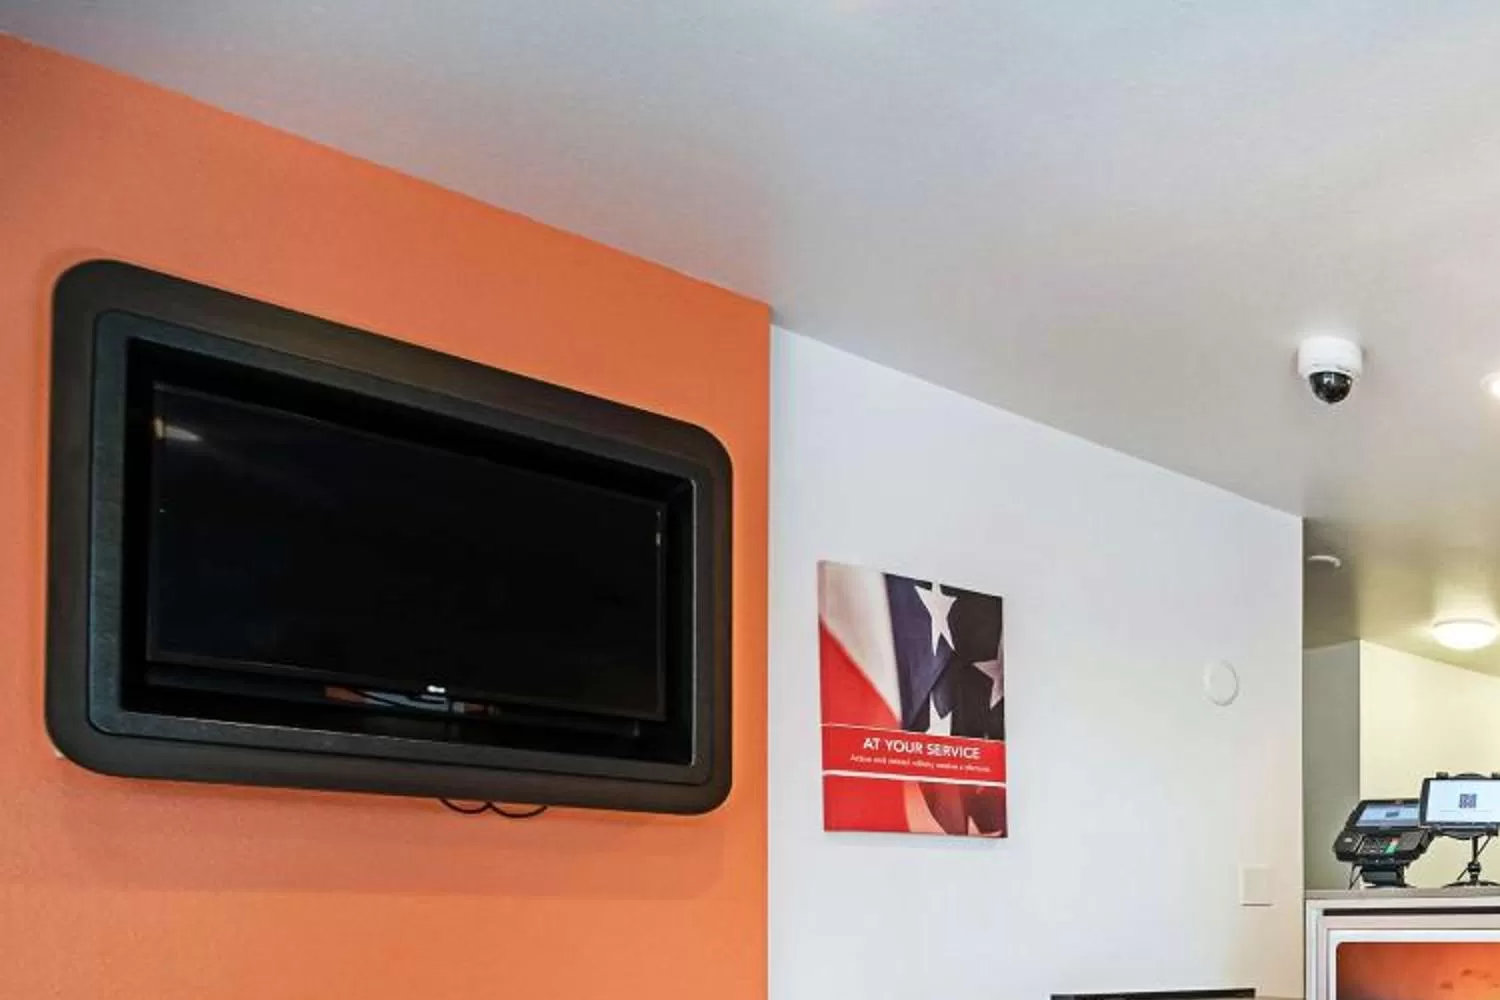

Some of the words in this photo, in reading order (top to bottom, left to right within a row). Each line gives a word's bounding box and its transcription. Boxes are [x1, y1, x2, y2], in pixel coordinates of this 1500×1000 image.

[863, 737, 880, 750] AT
[884, 739, 923, 754] YOUR
[927, 743, 981, 760] SERVICE
